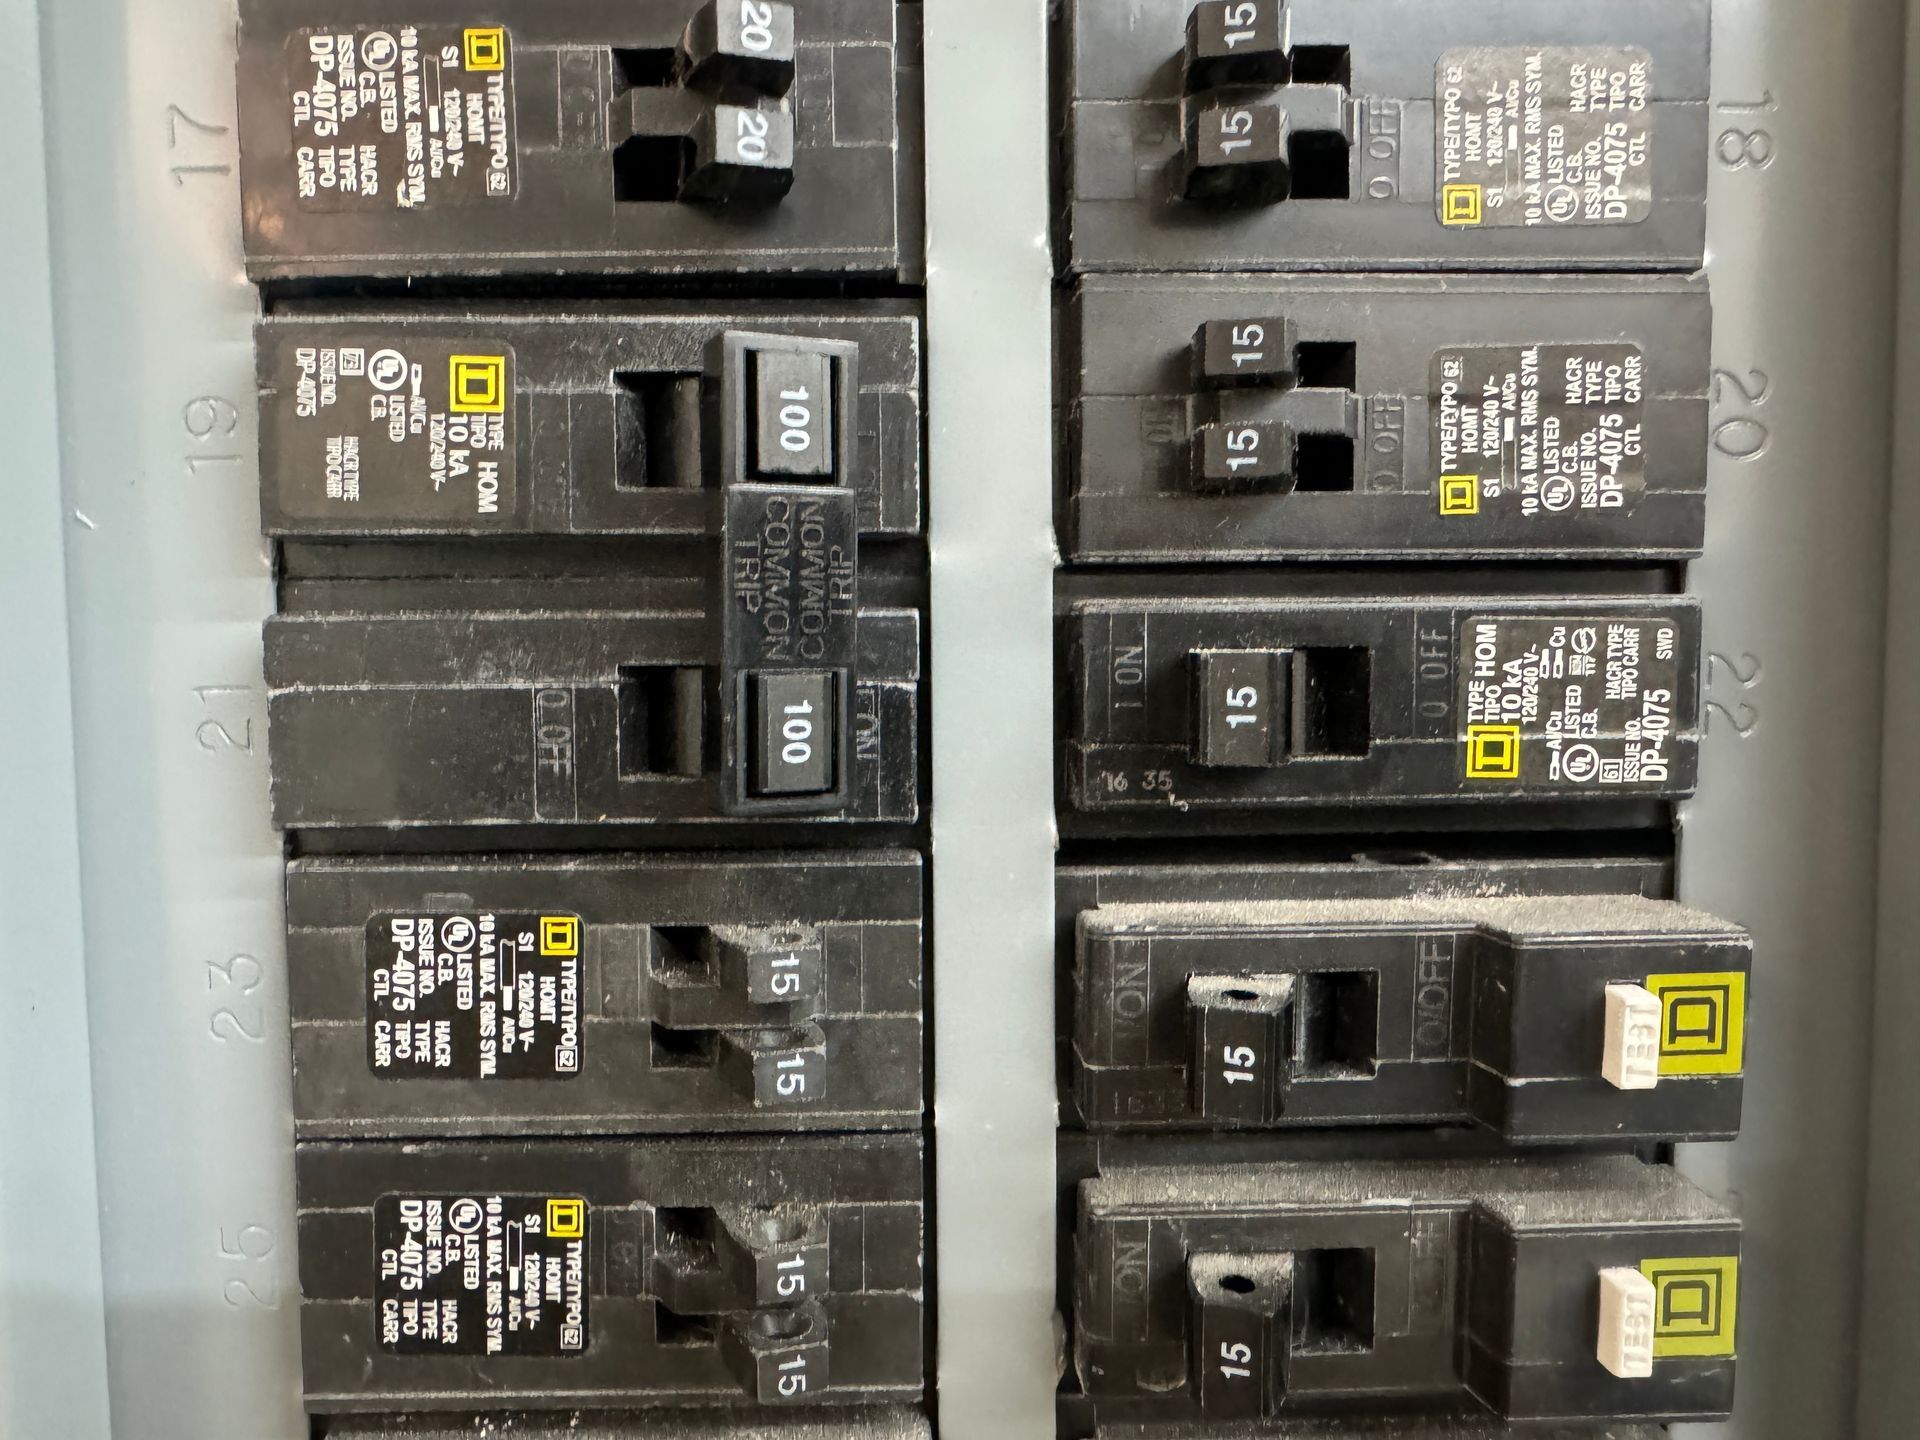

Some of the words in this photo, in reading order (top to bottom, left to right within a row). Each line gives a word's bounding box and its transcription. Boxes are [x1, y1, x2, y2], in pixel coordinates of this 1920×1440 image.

[740, 0, 772, 51] 20
[1224, 2, 1257, 49] 15
[337, 35, 356, 88] ISSUE
[1525, 52, 1542, 94] SYM.
[309, 35, 338, 136] DP-4075
[379, 72, 397, 133] LISTED
[1570, 64, 1586, 113] HACR
[1590, 68, 1607, 113] TYPE
[1608, 72, 1626, 112] TIPO
[1629, 63, 1646, 112] CARR
[293, 91, 310, 126] CTL
[1524, 96, 1541, 134] RMS
[1713, 88, 1776, 170] 18
[168, 103, 232, 188] 17
[737, 111, 768, 160] 20
[1219, 111, 1253, 158] 15
[1444, 88, 1461, 181] TYPE/TYPO
[1487, 107, 1503, 166] 120/240
[1547, 125, 1564, 184] LISTED
[1585, 137, 1601, 166] NO.
[1628, 132, 1645, 166] CTL
[297, 147, 316, 198] CARR
[339, 145, 357, 192] TYPE
[360, 145, 378, 196] HACR
[1524, 138, 1541, 179] MAX.
[1603, 123, 1628, 219] DP-4075
[1487, 187, 1503, 208] S1
[1525, 208, 1542, 225] 10
[1585, 170, 1601, 219] ISSUE
[1231, 324, 1264, 368] 15
[1521, 346, 1539, 386] SYM.
[296, 348, 316, 417] DP-4075
[1565, 357, 1583, 404] HACR
[1585, 361, 1602, 404] TYPE
[1605, 365, 1621, 404] TIPO
[1624, 356, 1641, 403] CARR
[449, 413, 468, 442] 10
[780, 386, 811, 452] 100
[1440, 382, 1459, 473] TYPE/TYPO
[1461, 405, 1478, 453] HOMT
[1483, 400, 1500, 457] 120/240
[1521, 389, 1537, 425] RMS
[1710, 368, 1774, 462] 20
[184, 396, 244, 475] 19
[1225, 428, 1260, 472] 15
[1521, 429, 1538, 470] MAX.
[1543, 417, 1560, 474] LISTED
[1562, 441, 1578, 473] C.B.
[1580, 428, 1597, 456] NO.
[1624, 424, 1641, 455] CTL
[449, 450, 470, 477] kA
[1599, 414, 1623, 507] DP-4075
[478, 461, 498, 513] HOM
[1483, 478, 1499, 497] S1
[1521, 472, 1538, 494] kA
[1580, 460, 1597, 508] ISSUE
[1521, 498, 1539, 516] 10
[734, 535, 760, 616] TRIP
[763, 497, 791, 659] COMMON
[799, 500, 824, 659] COMMON
[1419, 628, 1449, 679] OFF
[1475, 625, 1497, 676] HOM
[1549, 627, 1565, 647] Cu
[1607, 624, 1624, 659] TYPE
[1623, 628, 1639, 665] CARR
[1656, 628, 1673, 659] SWD
[1113, 645, 1144, 684] ON
[1502, 658, 1523, 688] kA
[1605, 661, 1622, 699] HACR
[1621, 668, 1638, 700] TIPO
[1225, 686, 1258, 728] 15
[1467, 680, 1485, 723] TYPE
[1484, 685, 1501, 723] TIPO
[1502, 694, 1521, 723] 10
[1522, 667, 1539, 724] 120/240
[1564, 685, 1581, 739] LISTED
[1702, 652, 1761, 740] 22
[191, 684, 253, 752] 21
[781, 700, 812, 765] 100
[1581, 708, 1598, 738] C.B.
[1624, 717, 1641, 740] NO.
[1639, 689, 1671, 781] DP-4075
[1142, 769, 1172, 792] 35
[1604, 764, 1618, 779] 61
[1623, 743, 1641, 782] ISSUE
[418, 919, 434, 966] ISSUE
[479, 913, 495, 932] 10
[518, 932, 534, 952] S1
[373, 969, 390, 1001] CTL
[391, 919, 415, 1011] DP-4075
[419, 970, 435, 998] NO.
[457, 954, 473, 1010] LISTED
[770, 952, 800, 996] 15
[208, 953, 264, 1041] 23
[480, 1001, 496, 1037] RMS
[519, 971, 534, 1028] 120/240
[561, 958, 577, 1045] TYPE/TYPO
[375, 1020, 391, 1067] CARR
[395, 1020, 411, 1058] TIPO
[415, 1021, 431, 1063] TYPE
[435, 1021, 451, 1067] HACR
[1625, 1004, 1656, 1082] TEST
[776, 1053, 805, 1096] 15
[1222, 1045, 1257, 1085] 15
[426, 1200, 442, 1247] ISSUE
[486, 1196, 502, 1213] 10
[525, 1214, 540, 1233] S1
[219, 1223, 277, 1307] 25
[382, 1249, 397, 1280] CTL
[400, 1200, 422, 1290] DP-4075
[426, 1250, 442, 1278] NO.
[463, 1234, 479, 1289] LISTED
[525, 1252, 540, 1307] 120/240
[566, 1240, 582, 1324] TYPE/TYPO
[777, 1253, 805, 1296] 15
[402, 1299, 419, 1335] TIPO
[422, 1299, 438, 1339] TYPE
[487, 1281, 502, 1315] RMS
[383, 1299, 399, 1343] CARR
[442, 1300, 457, 1344] HACR
[1623, 1294, 1650, 1369] TEST
[777, 1353, 806, 1396] 15
[1219, 1341, 1253, 1380] 15
